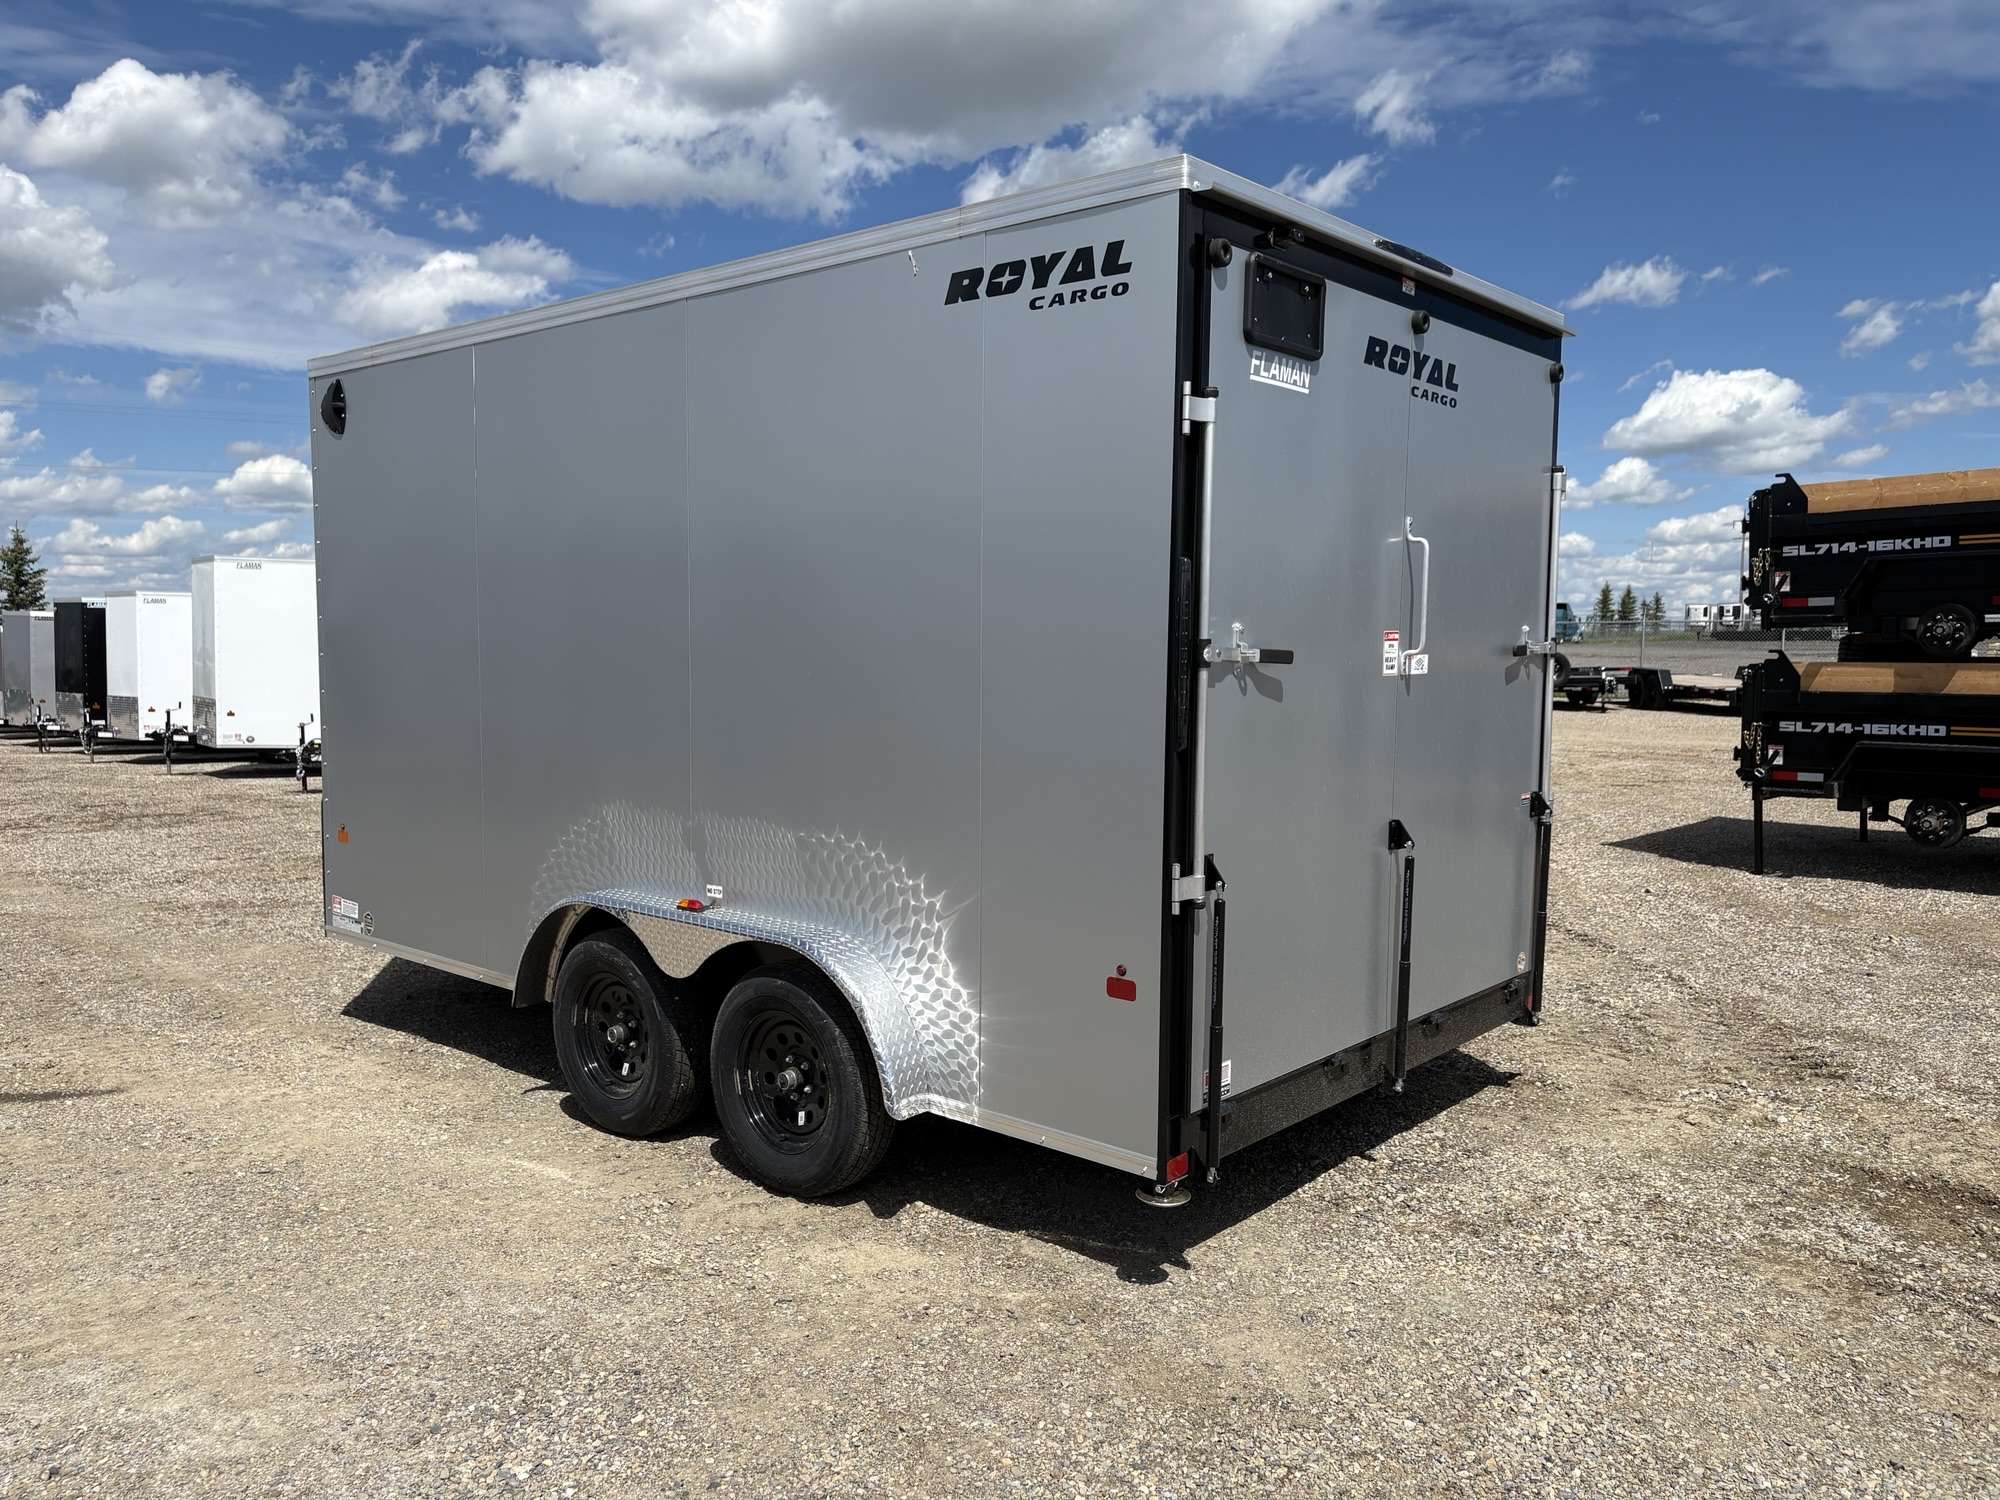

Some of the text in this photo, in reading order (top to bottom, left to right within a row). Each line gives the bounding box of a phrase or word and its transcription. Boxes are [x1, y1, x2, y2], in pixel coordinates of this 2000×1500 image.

[944, 240, 1132, 305] ROYAL
[1029, 282, 1129, 311] CARGO
[1250, 350, 1310, 388] FLAMAN
[1364, 336, 1458, 392] ROYAL
[1411, 386, 1457, 408] CARGO
[1782, 535, 1952, 557] SL714-16KHD
[1778, 721, 1947, 736] SL714-16KHD
